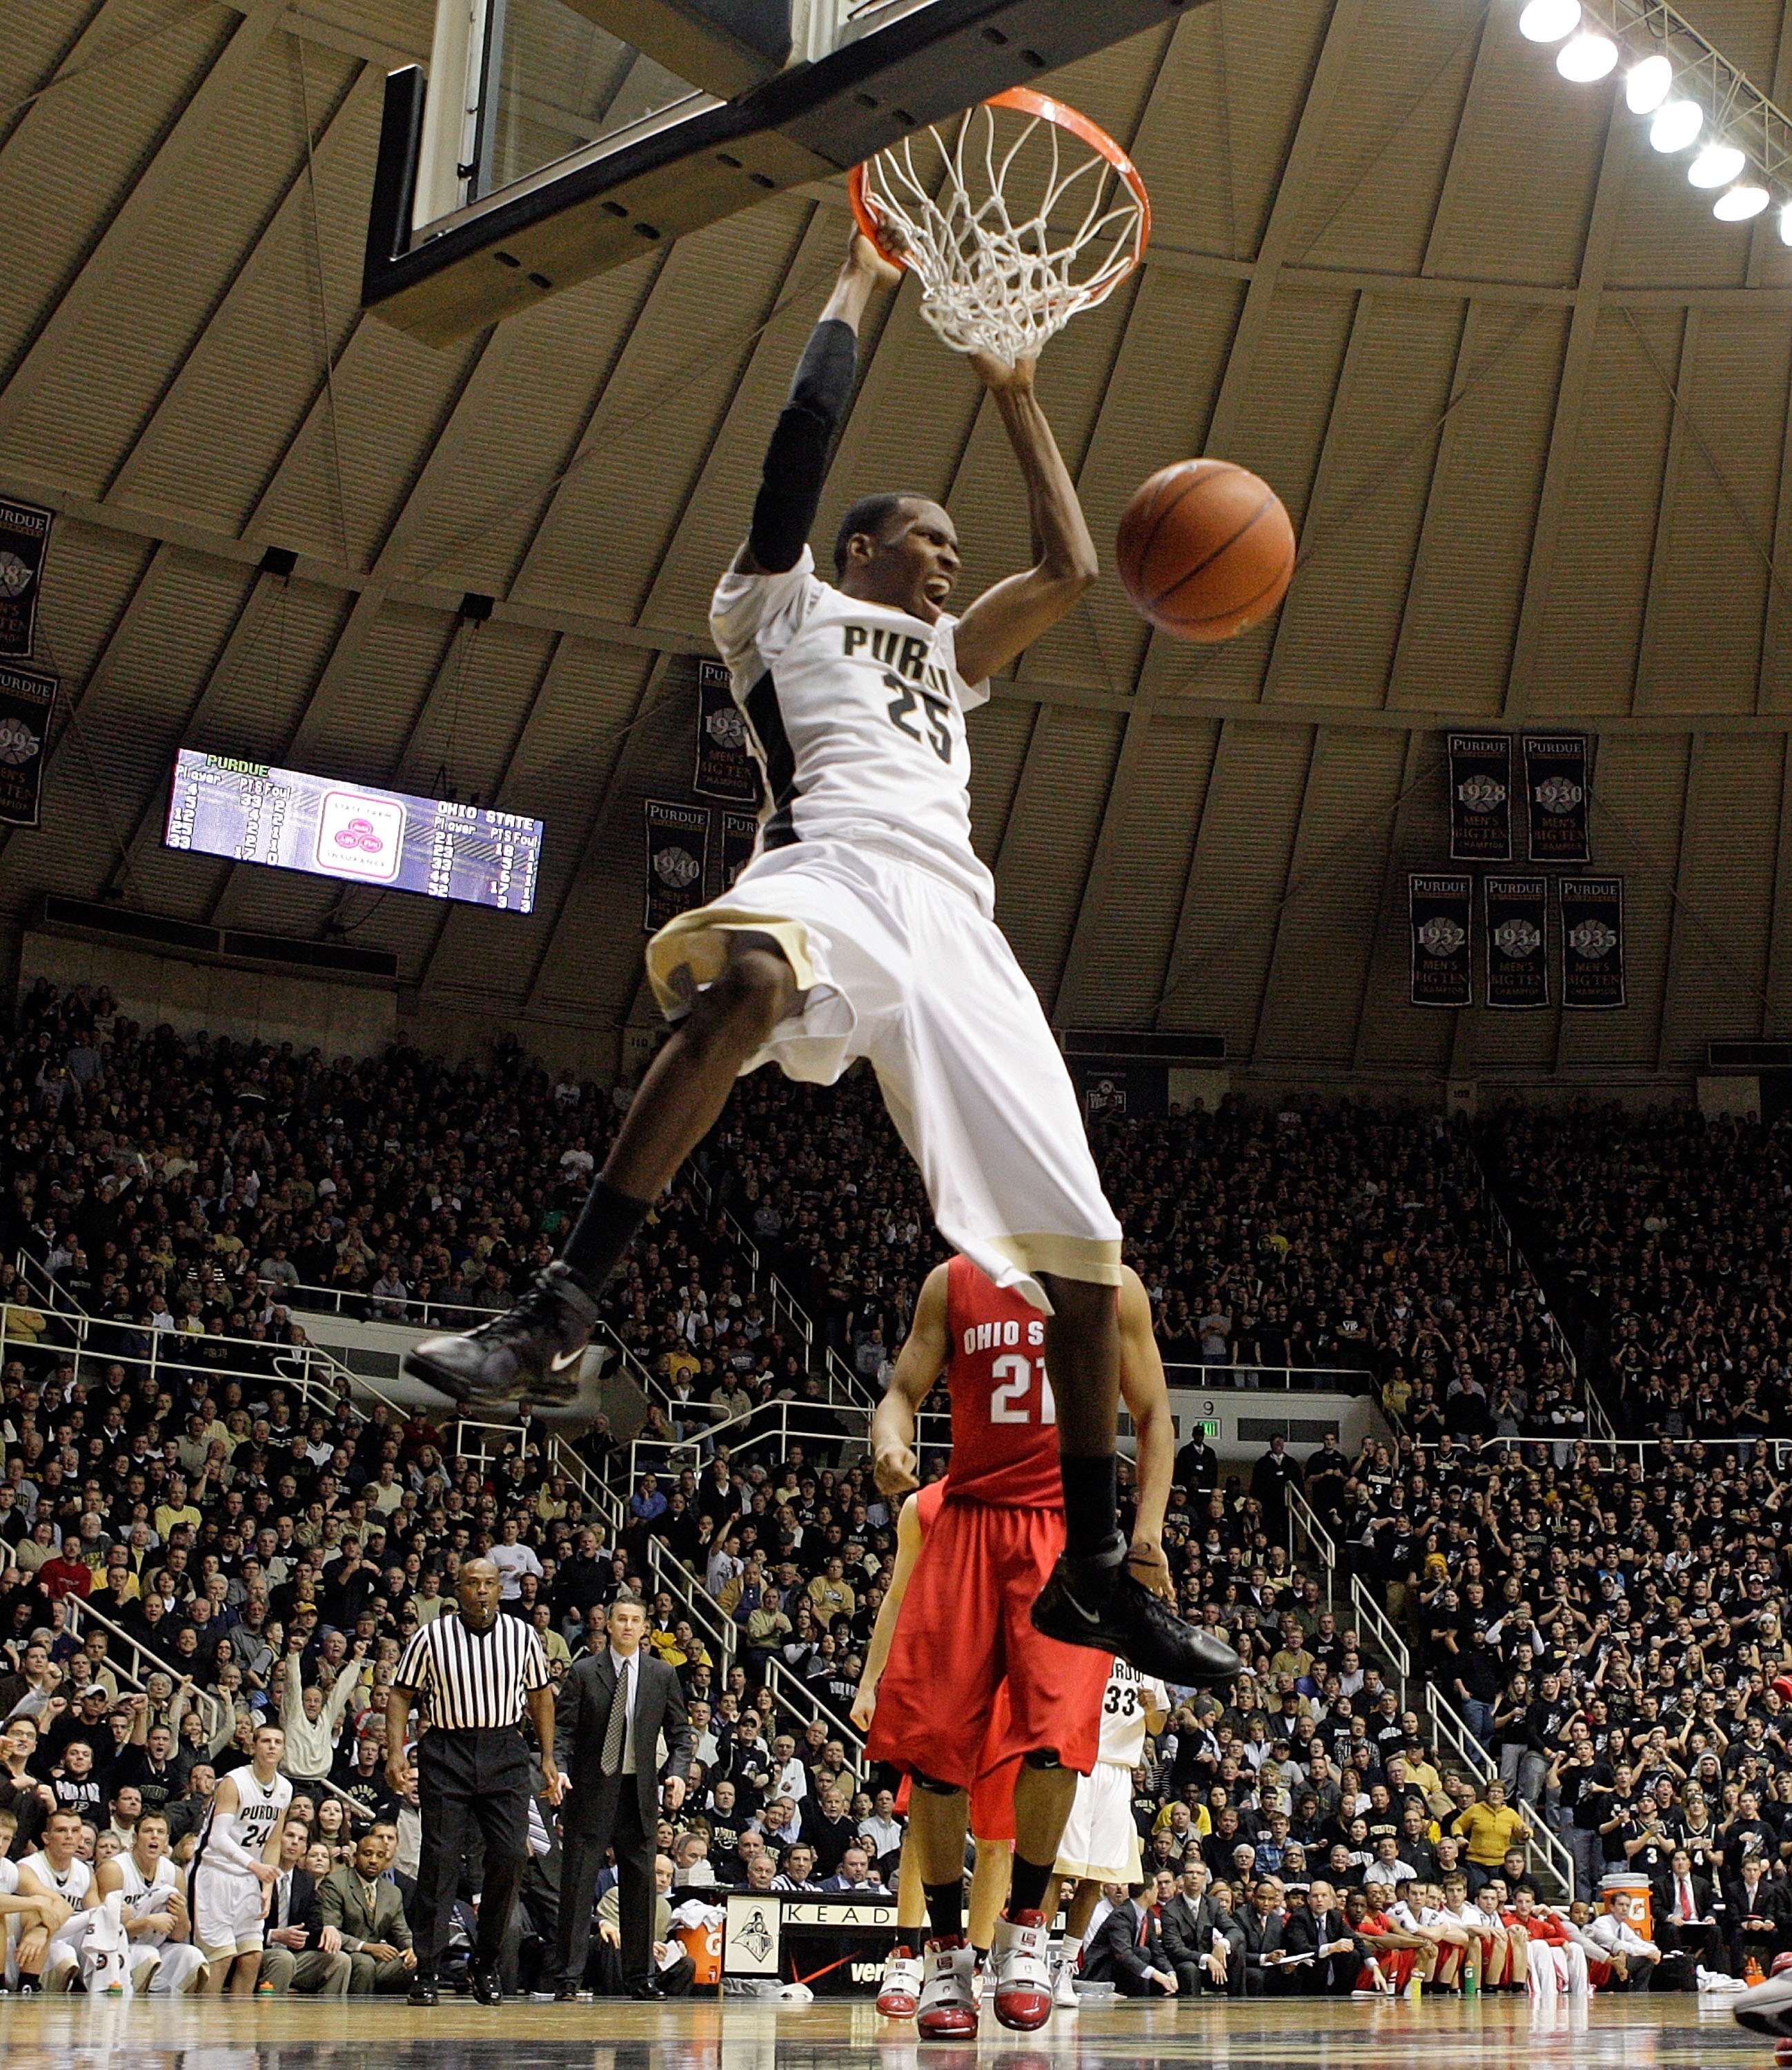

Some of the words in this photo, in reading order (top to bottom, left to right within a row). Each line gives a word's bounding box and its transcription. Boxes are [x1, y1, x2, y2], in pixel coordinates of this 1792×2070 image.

[0, 674, 50, 698] URDUE
[883, 673, 951, 765] 25
[1453, 739, 1507, 751] PURDUE
[1528, 740, 1582, 753] PURDUE
[206, 754, 270, 778] PURDUE
[176, 765, 221, 785] Player
[239, 777, 264, 794] PTS
[1457, 785, 1506, 801] 1928
[1535, 785, 1582, 803] 1930
[174, 807, 196, 822] 12
[437, 800, 477, 819] OHIO
[486, 810, 535, 831] STATE
[650, 805, 705, 825] PURDUE
[170, 820, 194, 835] 25
[434, 816, 477, 836] Player
[490, 827, 513, 842] PTS
[513, 831, 538, 847] Foul
[727, 817, 757, 832] PUR
[435, 831, 453, 846] 21
[495, 842, 515, 857] 18
[528, 849, 535, 862] 1
[433, 844, 454, 858] 23
[501, 856, 513, 870] 5
[526, 862, 534, 874] 1
[653, 854, 700, 878] 1940
[432, 857, 453, 871] 33
[524, 874, 532, 887] 1
[428, 882, 449, 897] 52
[430, 870, 450, 885] 44
[490, 880, 510, 896] 17
[523, 887, 531, 900] 1
[1413, 880, 1468, 892] PURDUE
[1489, 880, 1543, 894] PURDUE
[1564, 883, 1618, 896] PURDUE
[1417, 926, 1466, 945] 1932
[1494, 928, 1541, 947] 1934
[1568, 929, 1617, 947] 1935
[963, 1321, 1020, 1354] OHIO
[991, 1354, 1056, 1424] 21
[1203, 1401, 1214, 1416] 9
[1375, 1484, 1382, 1495] 3
[1104, 1685, 1136, 1717] 33
[241, 1825, 270, 1848] 24
[1646, 1847, 1657, 1864] 3
[1694, 1850, 1704, 1866] 4
[1464, 1967, 1473, 1978] G
